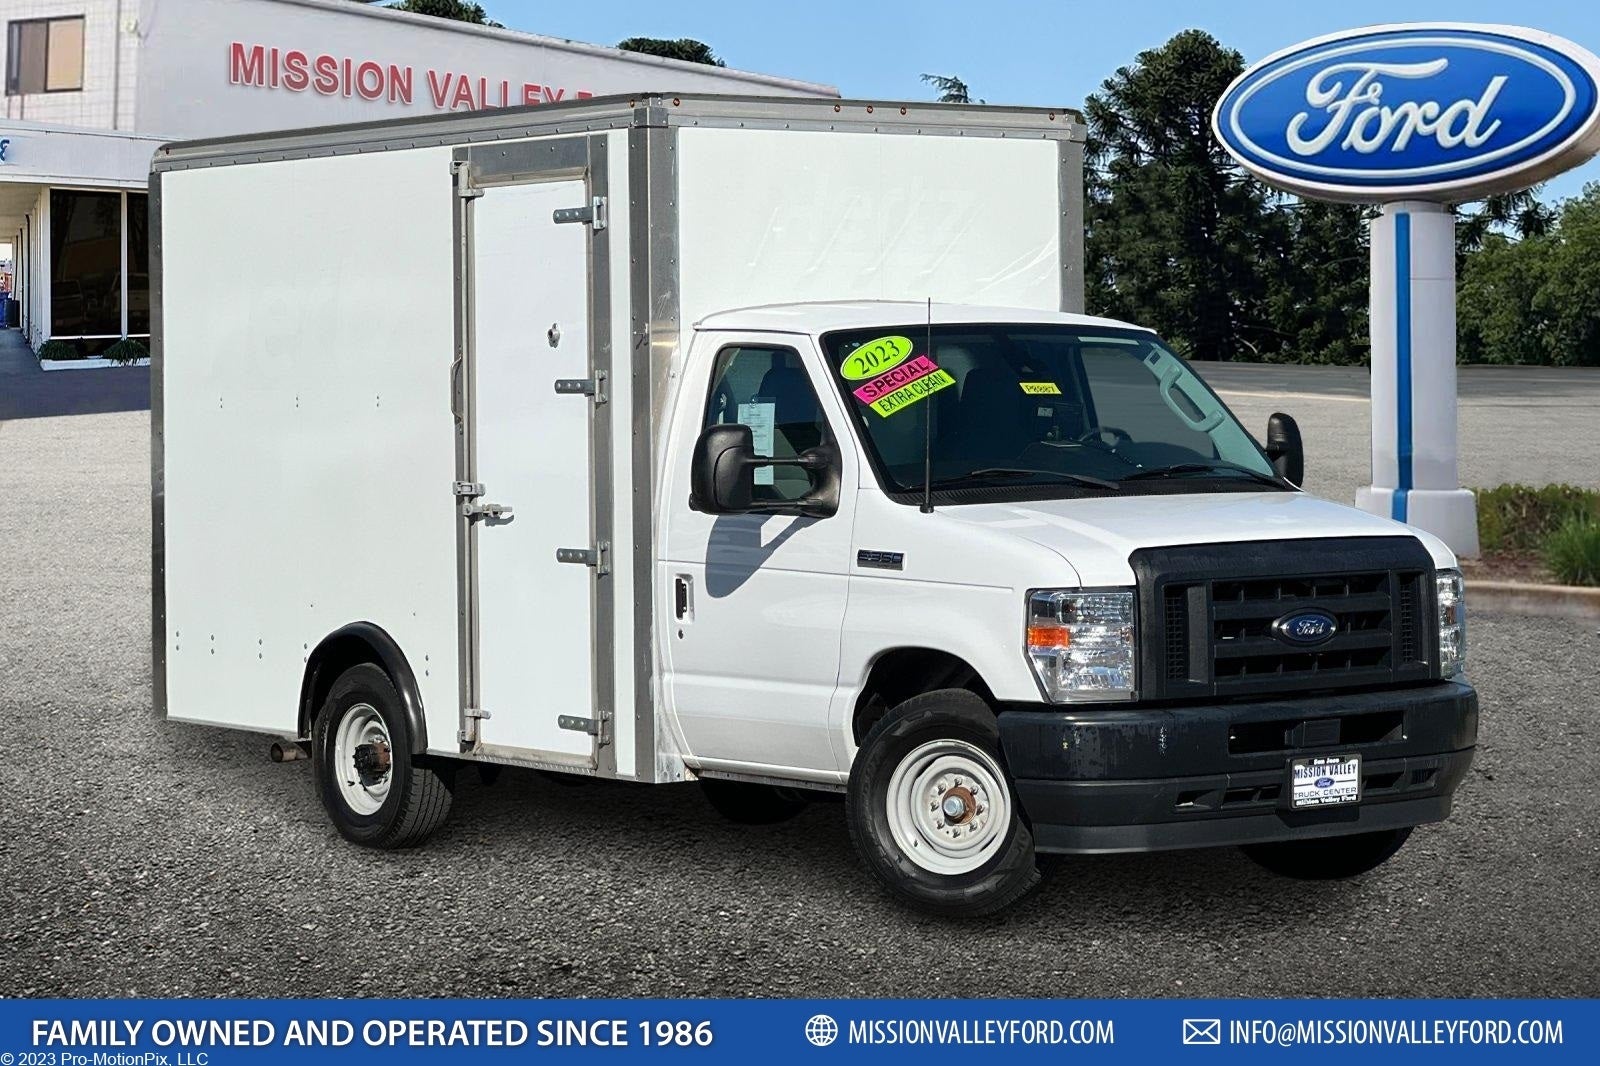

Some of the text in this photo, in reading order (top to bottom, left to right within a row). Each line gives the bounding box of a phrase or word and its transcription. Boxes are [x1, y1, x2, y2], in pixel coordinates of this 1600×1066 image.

[230, 41, 413, 104] MISSION
[1286, 57, 1509, 156] Ford
[854, 340, 900, 375] 2023
[863, 360, 929, 398] SPECIAL
[877, 373, 947, 412] EXTRA CLEAN
[1296, 619, 1325, 635] Ford
[1294, 763, 1357, 779] MISSION VALLEY
[1316, 778, 1332, 788] Ford
[1295, 787, 1357, 798] TRUCK CENTER
